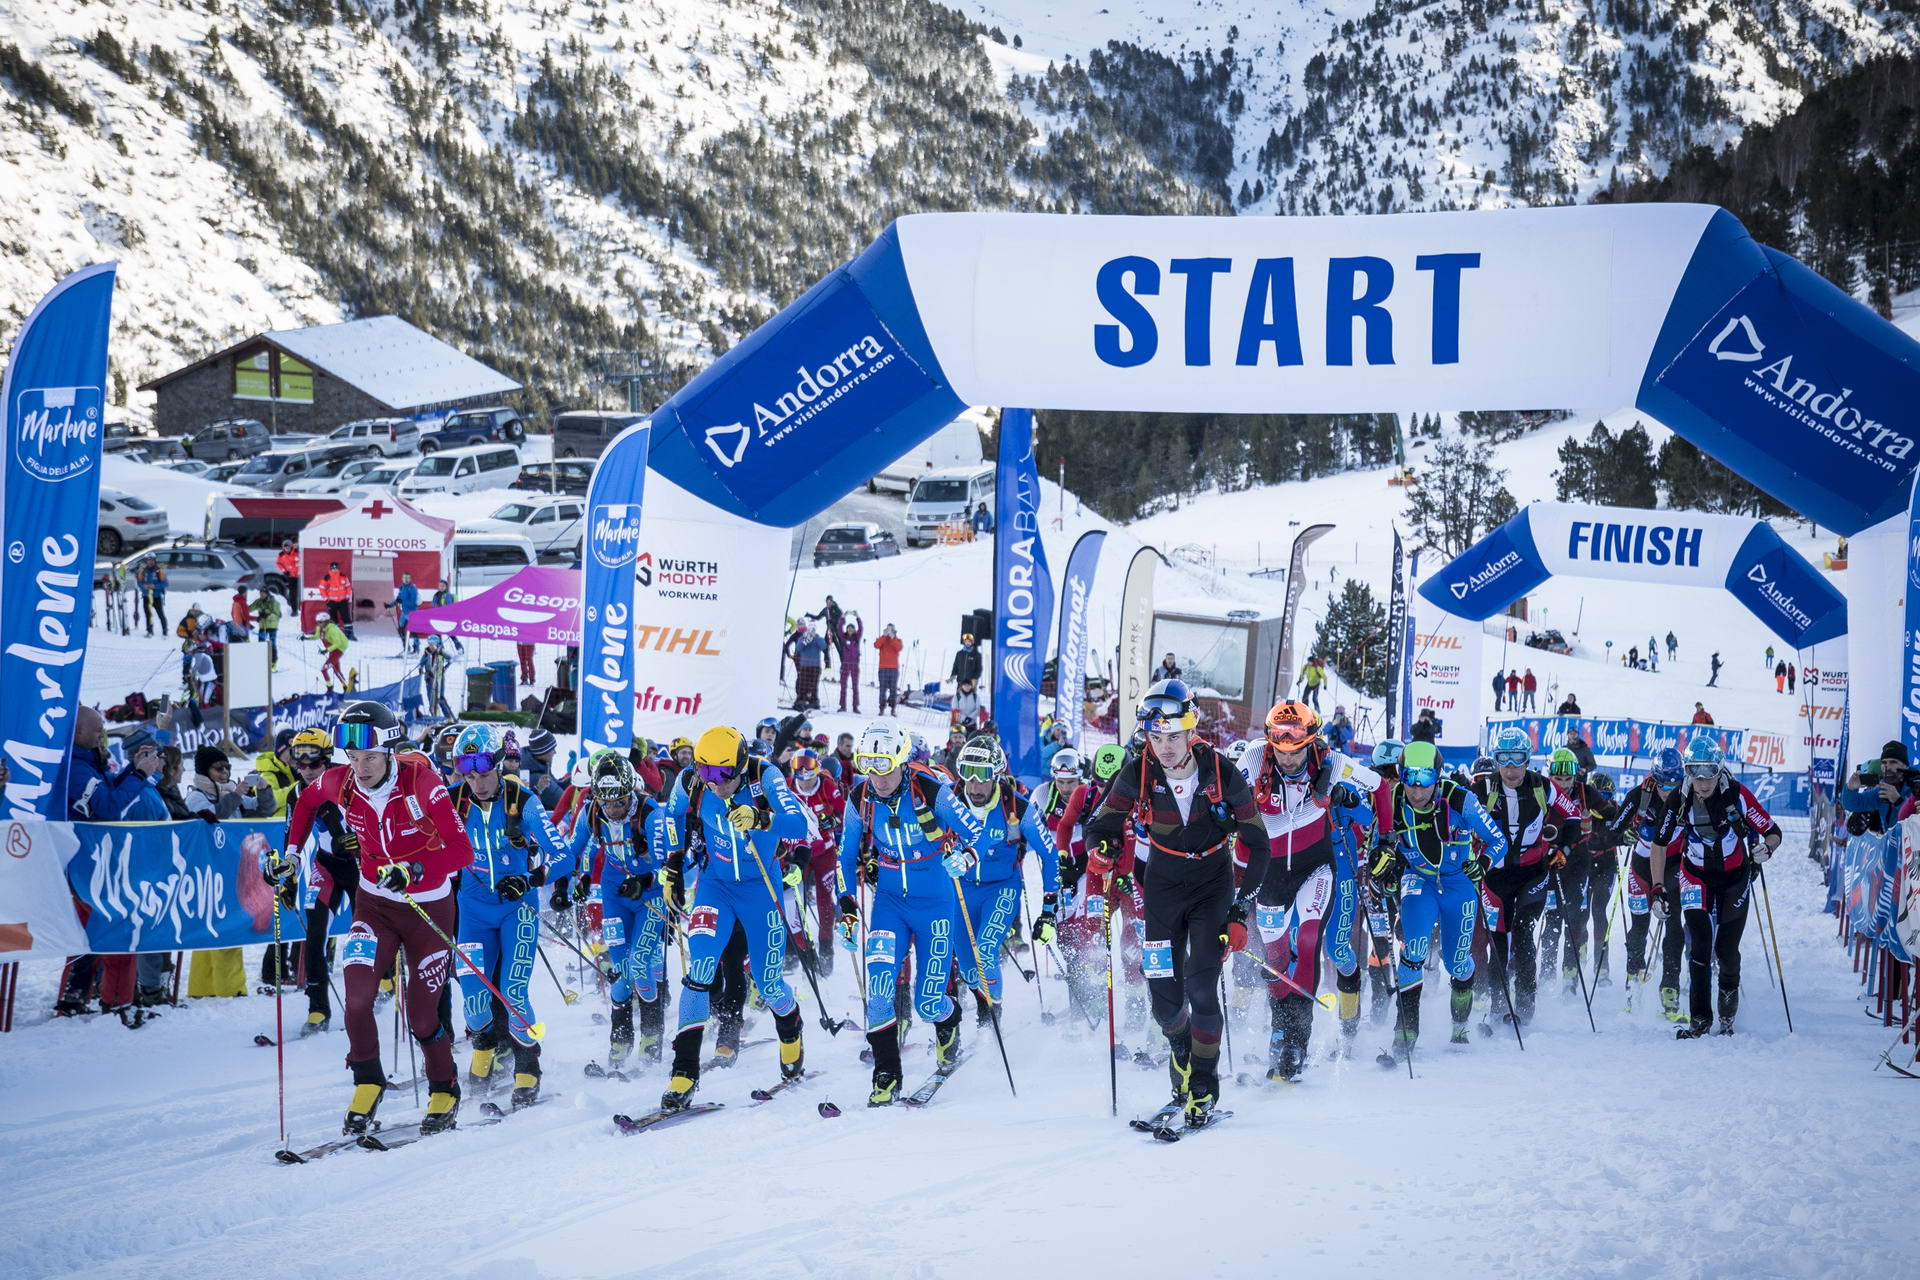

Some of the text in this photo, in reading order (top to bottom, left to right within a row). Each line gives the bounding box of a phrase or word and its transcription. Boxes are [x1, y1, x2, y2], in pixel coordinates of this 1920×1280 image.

[1094, 253, 1481, 368] START
[752, 335, 884, 438] Andorra
[764, 353, 895, 448] www.visitandorra.com
[1752, 354, 1915, 460] Andorra
[21, 408, 97, 457] Marlene
[1744, 376, 1897, 473] www.visitandorra.com
[319, 536, 427, 550] PUNT DE SOCORS
[1568, 521, 1703, 567] FINISH
[658, 572, 718, 586] MODYF
[1469, 550, 1520, 589] Andorra
[504, 587, 582, 612] Gasop
[658, 590, 719, 601] WORKWEAR
[1763, 580, 1813, 628] Andorra
[461, 619, 519, 638] Gasopas
[637, 624, 722, 656] TIHL
[1799, 704, 1843, 720] STIH
[1745, 735, 1786, 765] STIHL
[1814, 770, 1834, 779] ISMF
[536, 804, 567, 850] ITALIA
[1473, 800, 1503, 839] ITALIA
[90, 829, 227, 952] Marlene
[1684, 892, 1695, 900] 46
[605, 927, 617, 937] 13
[699, 914, 704, 924] 1
[1266, 915, 1273, 924] 8
[355, 942, 363, 953] 3
[875, 939, 884, 950] 4
[1150, 952, 1158, 965] 6
